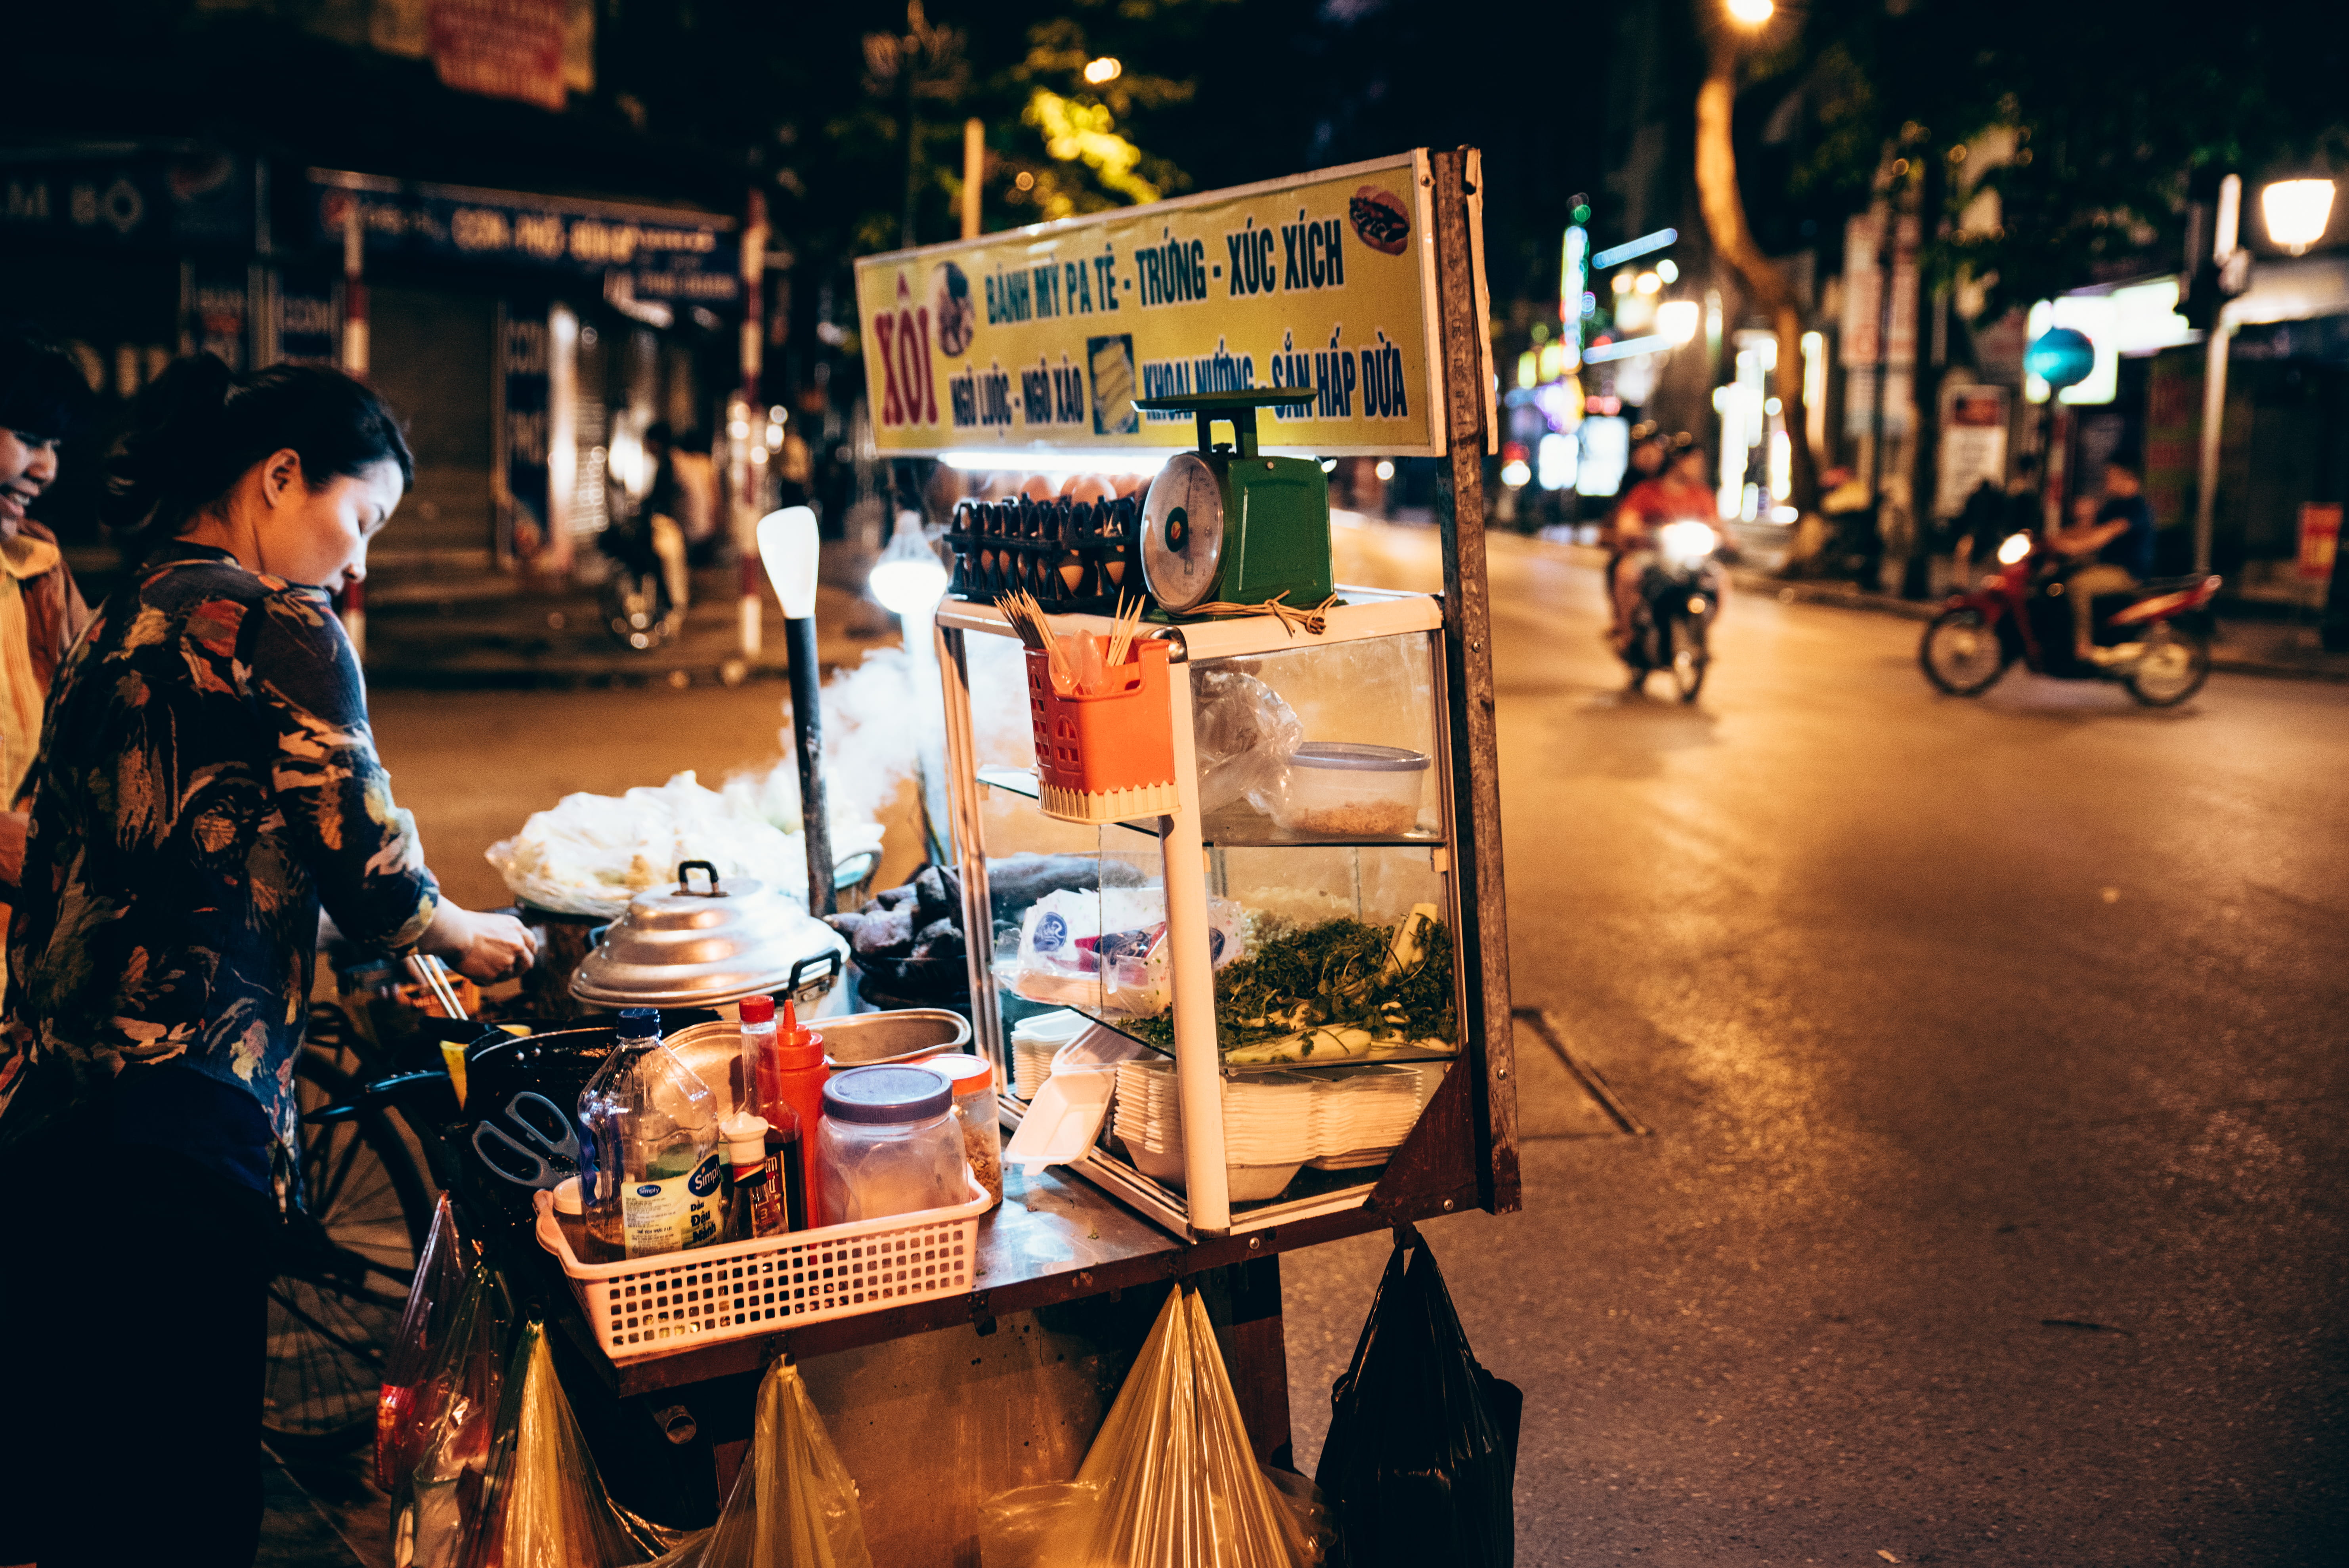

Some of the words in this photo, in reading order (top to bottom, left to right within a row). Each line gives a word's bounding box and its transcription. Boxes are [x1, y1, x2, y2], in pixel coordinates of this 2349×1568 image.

[1094, 242, 1119, 310] TÊ
[1135, 227, 1206, 306] TRỨNG
[1227, 217, 1276, 296] XÚC
[1281, 209, 1344, 290] XÍCH
[874, 272, 938, 425] XÔI
[1315, 327, 1356, 417] HẤP
[1361, 331, 1408, 418] DỪA
